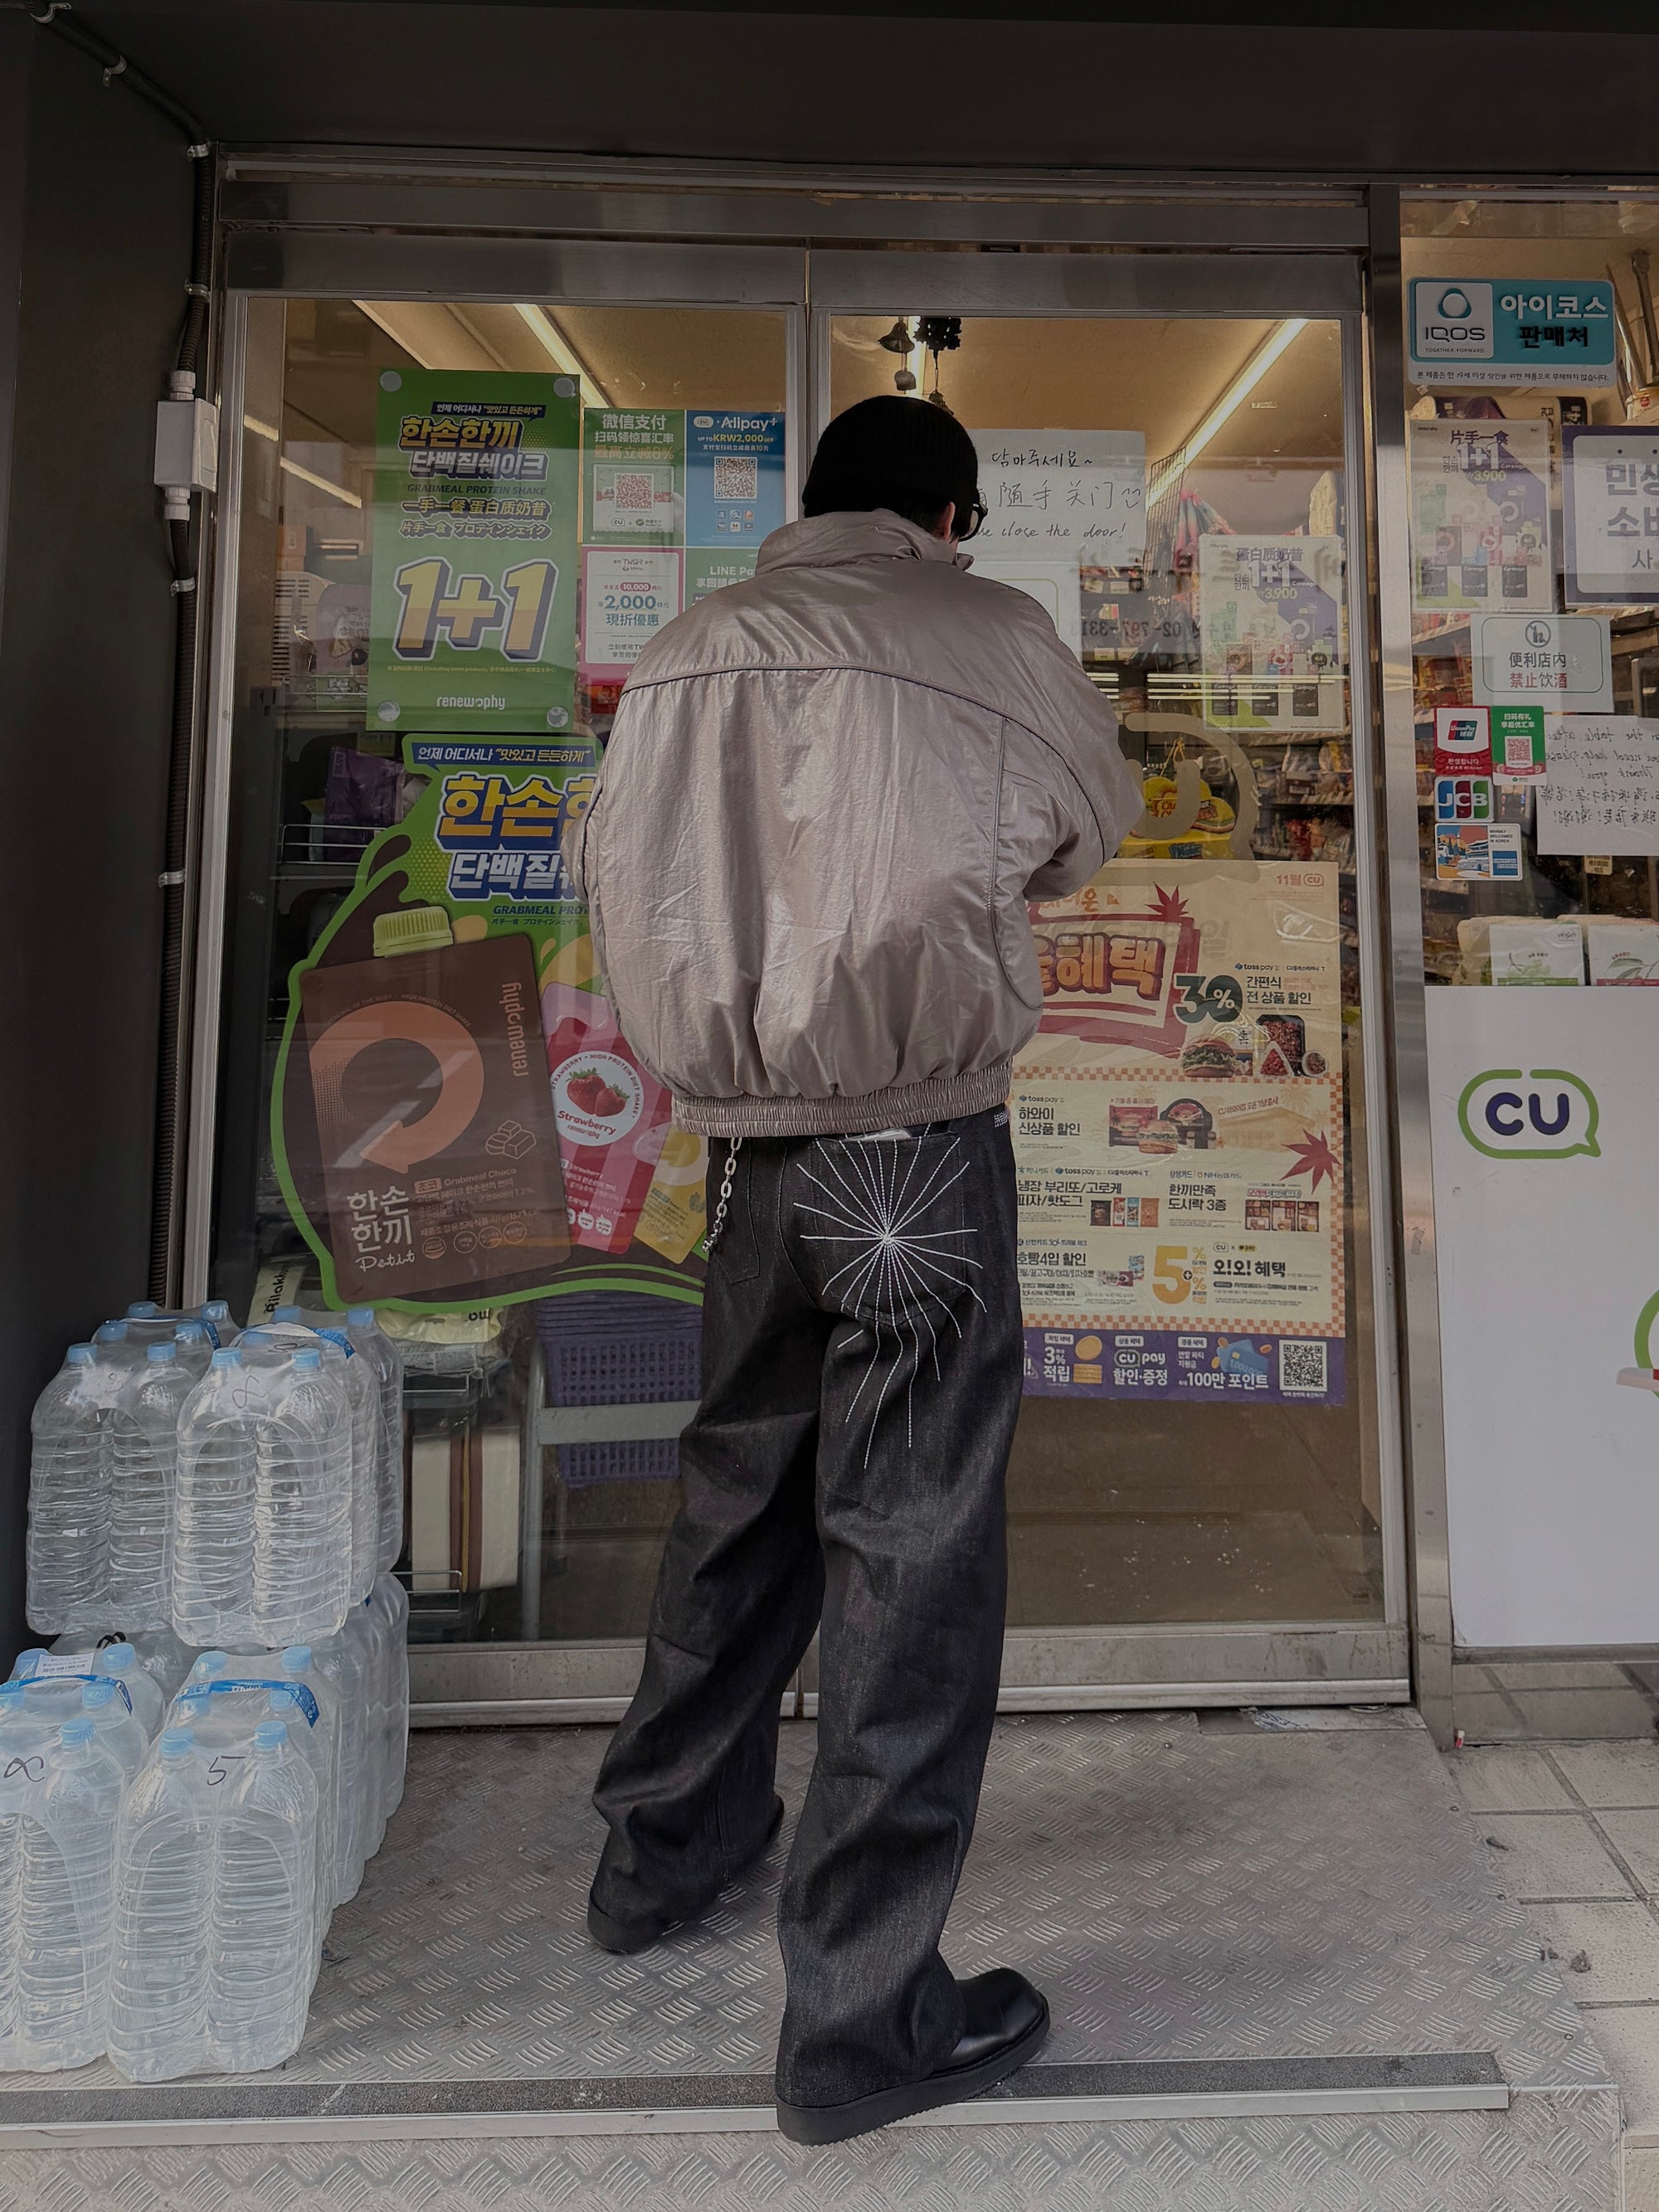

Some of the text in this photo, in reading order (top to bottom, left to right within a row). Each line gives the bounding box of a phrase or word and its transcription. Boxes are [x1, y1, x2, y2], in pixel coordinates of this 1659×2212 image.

[1500, 294, 1608, 320] 아이코스
[1425, 327, 1486, 343] IQOS
[1519, 325, 1588, 349] 판매처
[1425, 371, 1446, 380] 제품은
[436, 404, 452, 413] 언제
[453, 405, 482, 414] 어디서나
[601, 413, 667, 430] 微信支付
[400, 416, 522, 450] 한손한끼
[594, 430, 674, 445] 扫码领惊喜汇率
[1450, 430, 1510, 445] 片手一食
[1456, 441, 1500, 470] 1+1
[410, 450, 547, 479] 단백질쉐이크
[407, 484, 547, 496] GRABMEAL PROTEIN SHAKE
[403, 498, 547, 516] 一手一餐 蛋白质奶昔
[401, 522, 547, 535] 片手一食 プロテインシェイク
[1001, 521, 1126, 539] close the door!
[709, 566, 756, 576] LINE Pa
[1248, 559, 1291, 587] 1+1
[394, 557, 557, 661] 1+1
[604, 595, 657, 610] 2,000
[606, 613, 659, 626] 現折優惠
[1508, 651, 1567, 668] 便利店内
[1509, 673, 1568, 689] 禁止饮酒
[417, 747, 441, 761] 언제
[445, 748, 494, 761] 어디서나
[449, 853, 574, 891] 단백질
[493, 905, 556, 916] GRABMEAL
[1246, 975, 1282, 989] 간편식
[1246, 991, 1311, 1005] 전 상품 할인
[1044, 1096, 1059, 1104] pay
[1019, 1106, 1054, 1121] 하와이
[1485, 1091, 1570, 1136] CU
[557, 1110, 617, 1135] Strawberry
[1019, 1122, 1081, 1136] 신상품 할인
[488, 1168, 518, 1179] Choco
[1170, 1170, 1193, 1179] 삼성카드
[1018, 1179, 1122, 1195] 냉장 부리또/고로케
[1169, 1184, 1217, 1197] 한끼만족
[347, 1185, 410, 1223] 한손
[1018, 1194, 1083, 1208] 피자/핫도그
[1168, 1198, 1227, 1212] 도시락 3종
[351, 1215, 413, 1253] 한끼
[1062, 1252, 1087, 1266] 할인
[1152, 1246, 1191, 1305] 5
[1213, 1259, 1252, 1276] 오!오!
[1254, 1260, 1286, 1278] 혜택
[1044, 1345, 1055, 1364] 3
[1141, 1353, 1166, 1365] pay
[1044, 1365, 1070, 1382] 적립
[1186, 1372, 1269, 1391] 100만 포인트
[207, 1755, 247, 1786] 5
